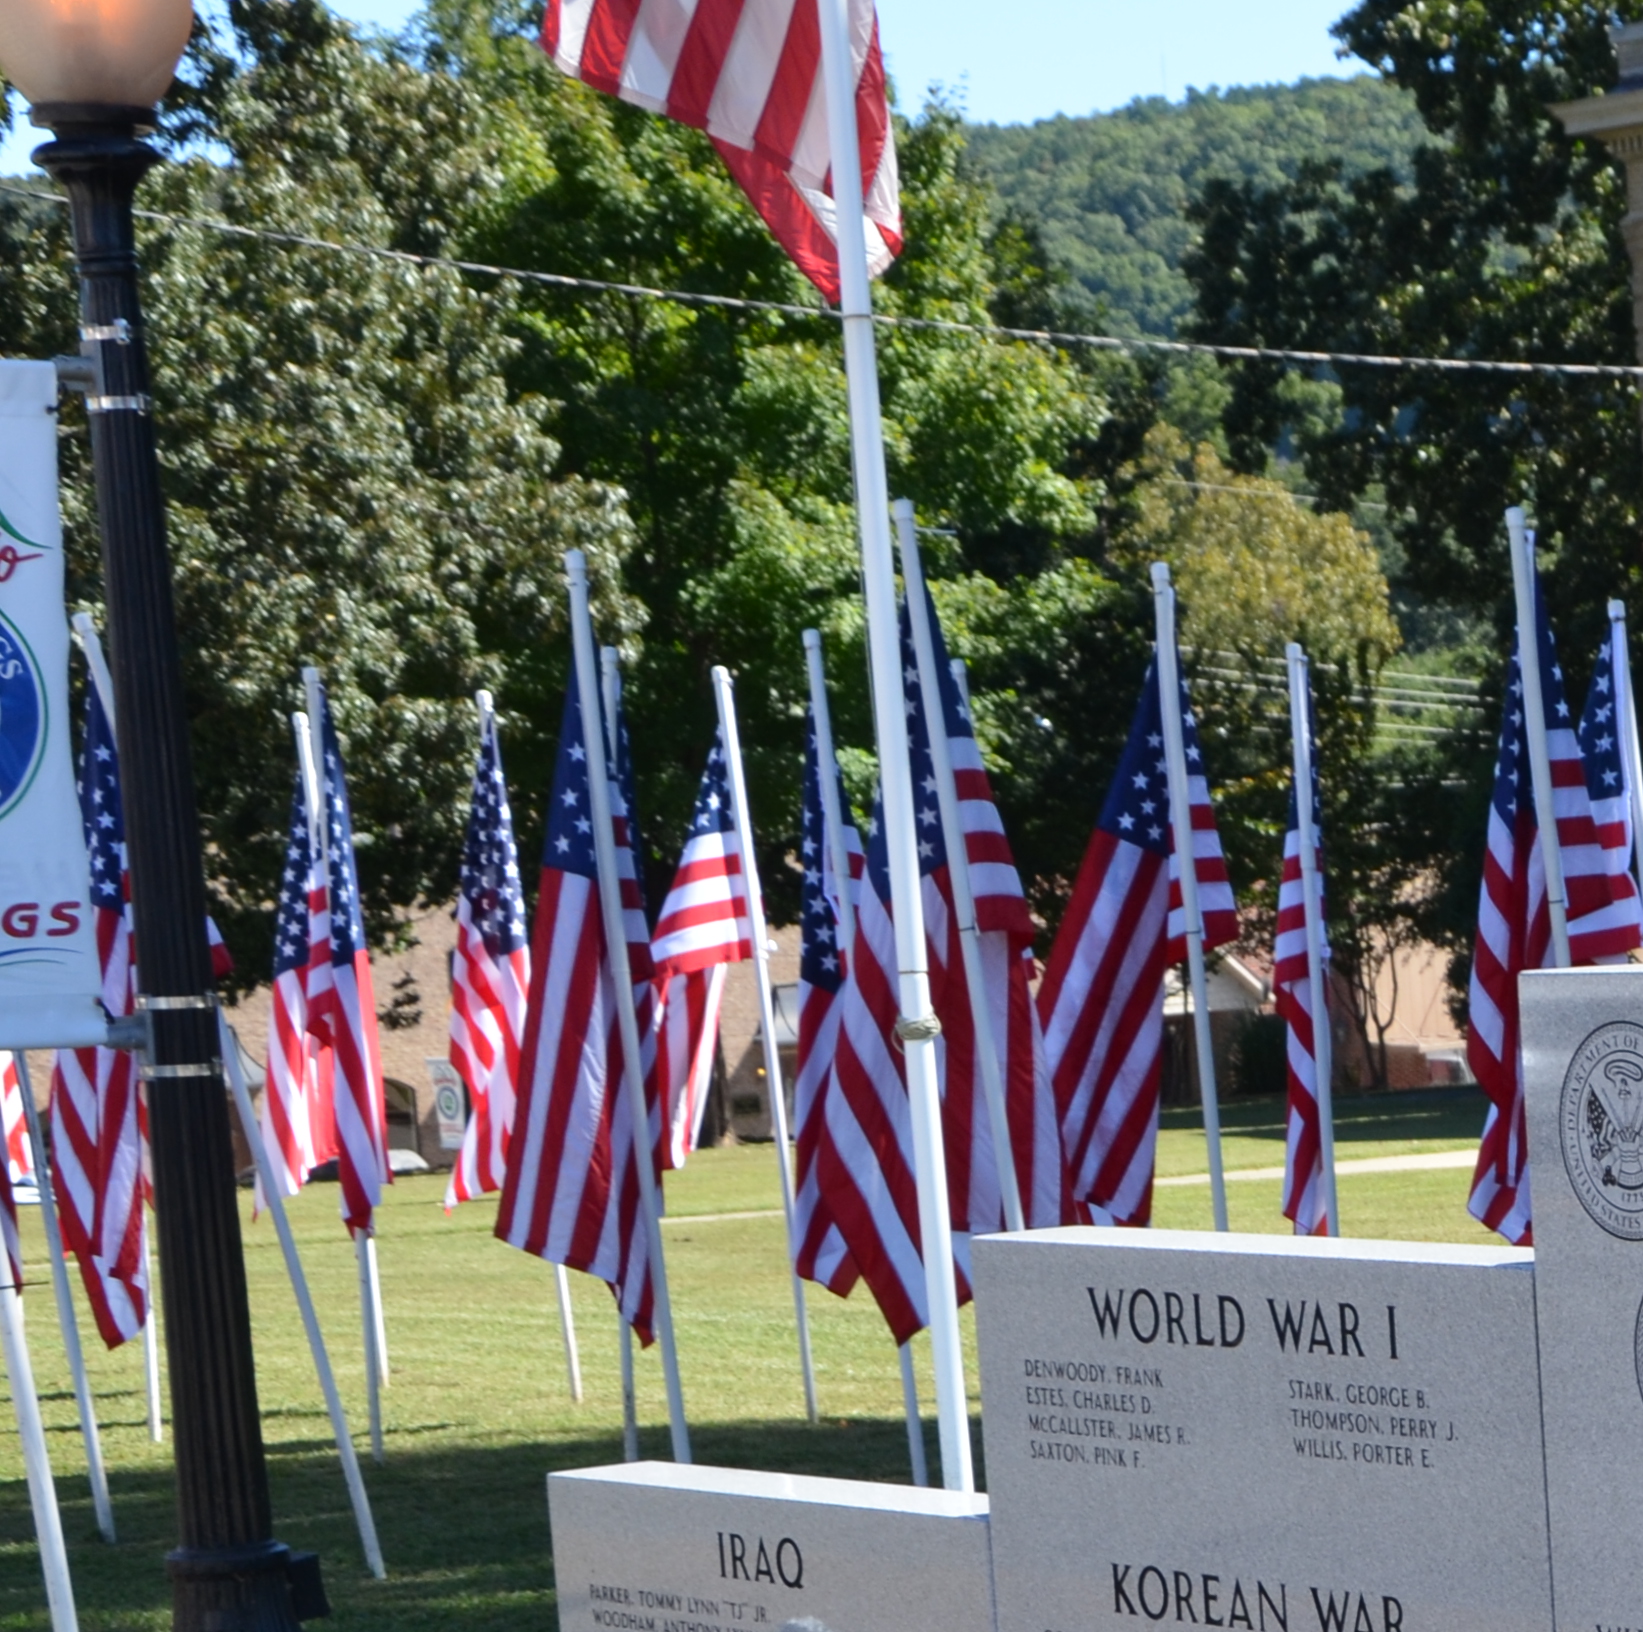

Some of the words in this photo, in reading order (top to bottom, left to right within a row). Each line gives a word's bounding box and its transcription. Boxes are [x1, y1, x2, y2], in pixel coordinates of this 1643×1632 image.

[1086, 1286, 1246, 1348] WORLD
[1266, 1297, 1366, 1358] WAR
[1386, 1305, 1400, 1360] I
[1116, 1367, 1163, 1387] FRANK
[1073, 1391, 1135, 1413] CHARLES
[1346, 1384, 1409, 1407] GEORGE
[1129, 1424, 1171, 1444] JAMES
[1391, 1417, 1436, 1438] PERRY
[1095, 1447, 1126, 1467] PINK
[1353, 1443, 1413, 1466] PORTER
[716, 1532, 805, 1590] IRAQ
[638, 1590, 681, 1609] TOMMY
[689, 1599, 719, 1614] LYNN
